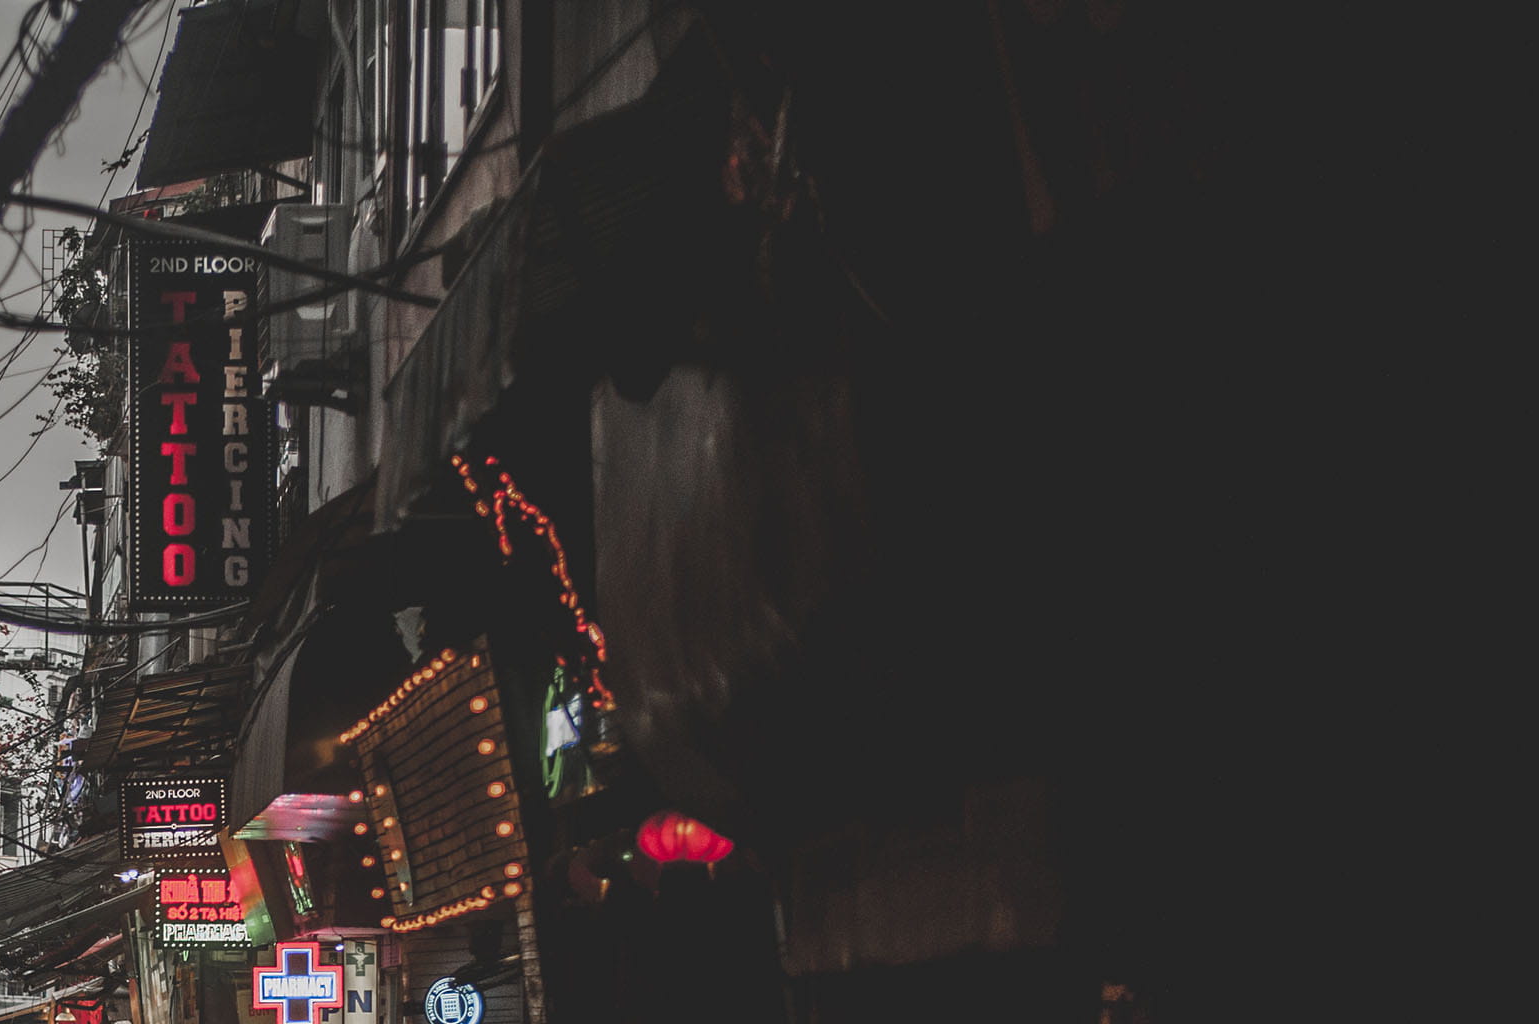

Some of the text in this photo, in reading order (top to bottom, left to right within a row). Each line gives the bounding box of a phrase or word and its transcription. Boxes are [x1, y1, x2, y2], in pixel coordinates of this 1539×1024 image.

[149, 256, 256, 273] 2ND FLOOR
[160, 290, 201, 588] TATTOO
[221, 289, 252, 588] PIERCING
[145, 788, 201, 800] 2ND FLOOR
[132, 803, 218, 823] TATTOO
[132, 831, 219, 848] PIERCING
[188, 906, 200, 920] 2
[263, 976, 333, 998] PHARMACY
